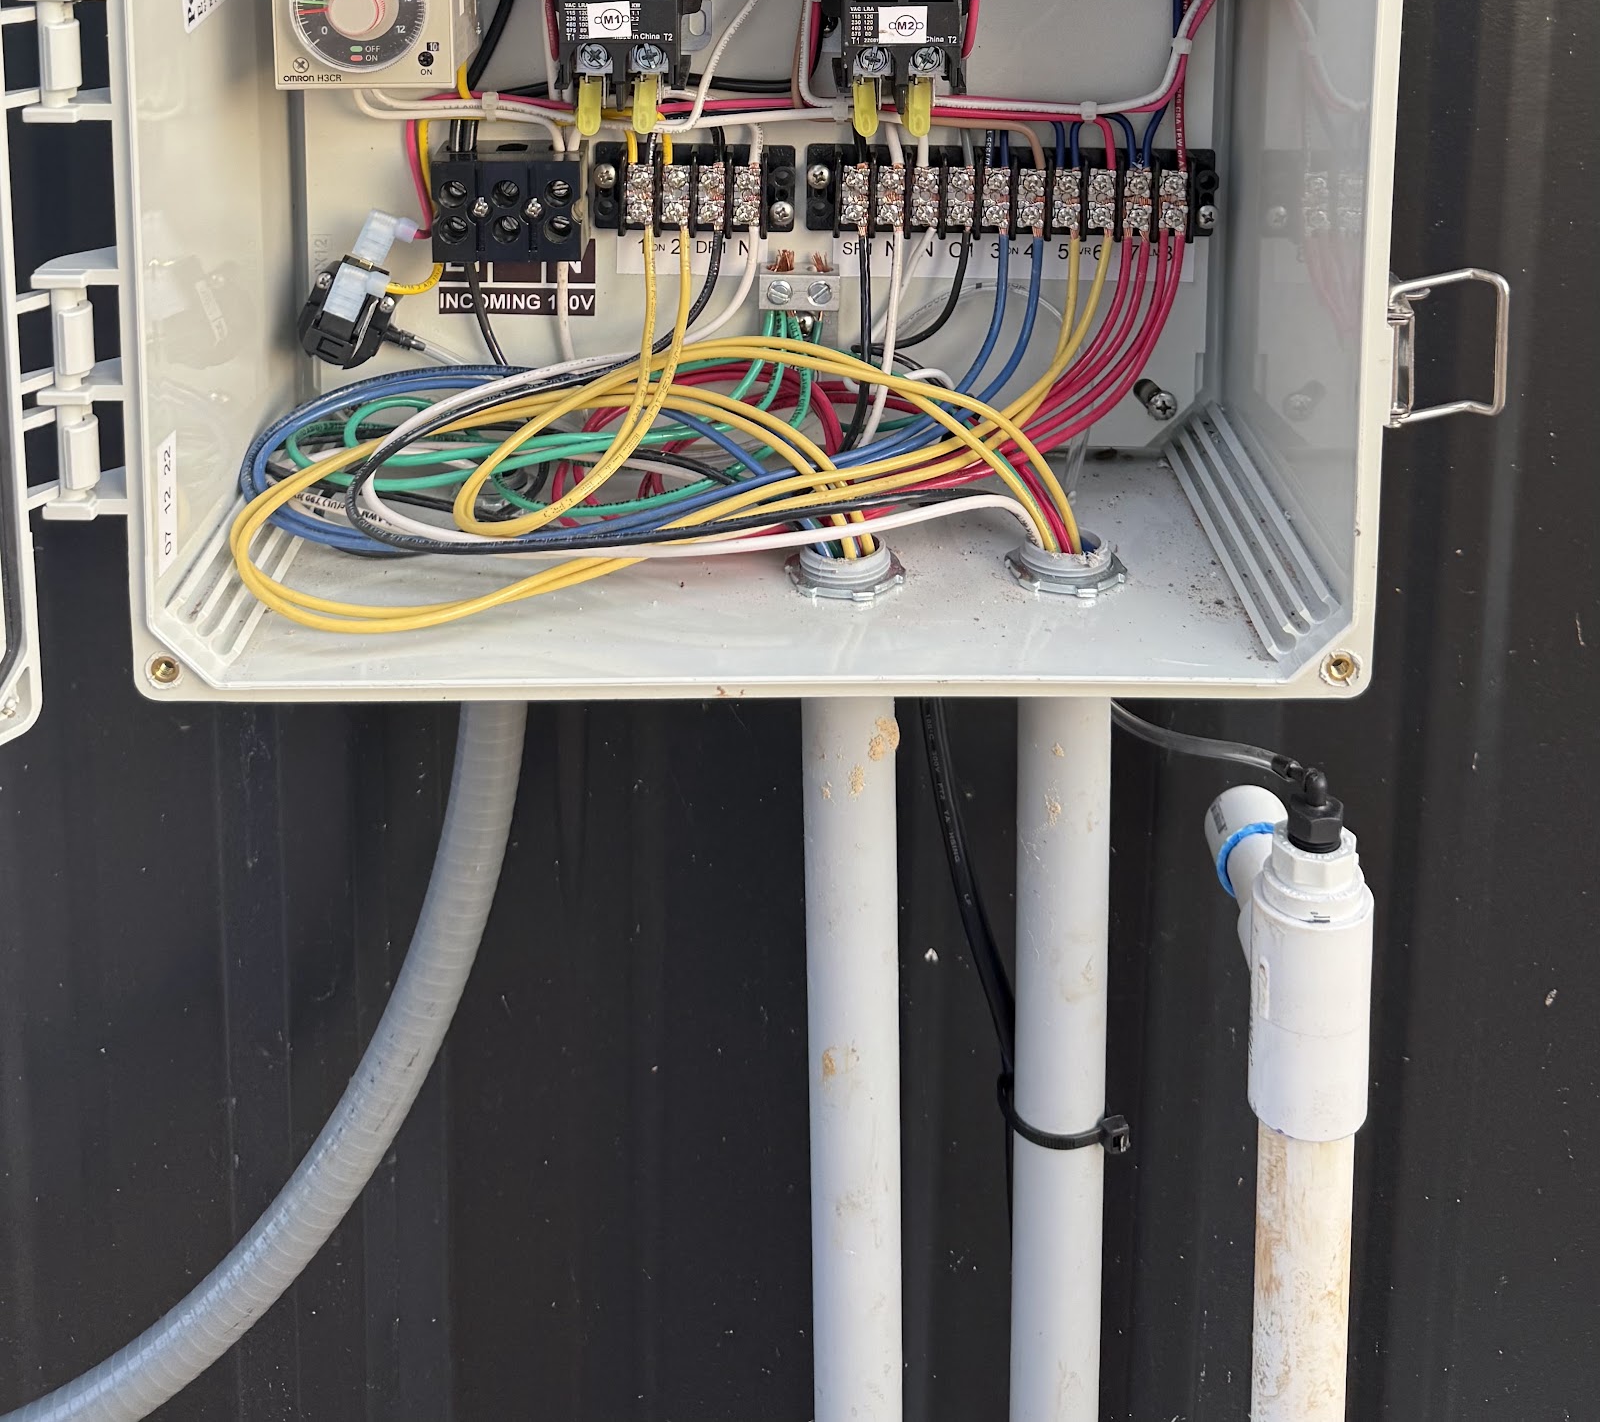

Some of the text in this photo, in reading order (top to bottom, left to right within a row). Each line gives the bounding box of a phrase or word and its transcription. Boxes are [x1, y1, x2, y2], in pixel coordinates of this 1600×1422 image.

[603, 16, 621, 24] M1
[395, 25, 406, 34] 12
[897, 22, 915, 30] M2
[948, 36, 957, 44] T2
[428, 43, 438, 51] 10
[317, 74, 342, 82] H3CR
[671, 238, 681, 254] 2
[991, 242, 1000, 258] 3
[1023, 244, 1034, 259] 4
[1058, 244, 1069, 259] 5
[548, 294, 594, 310] 10V
[163, 445, 171, 474] 22
